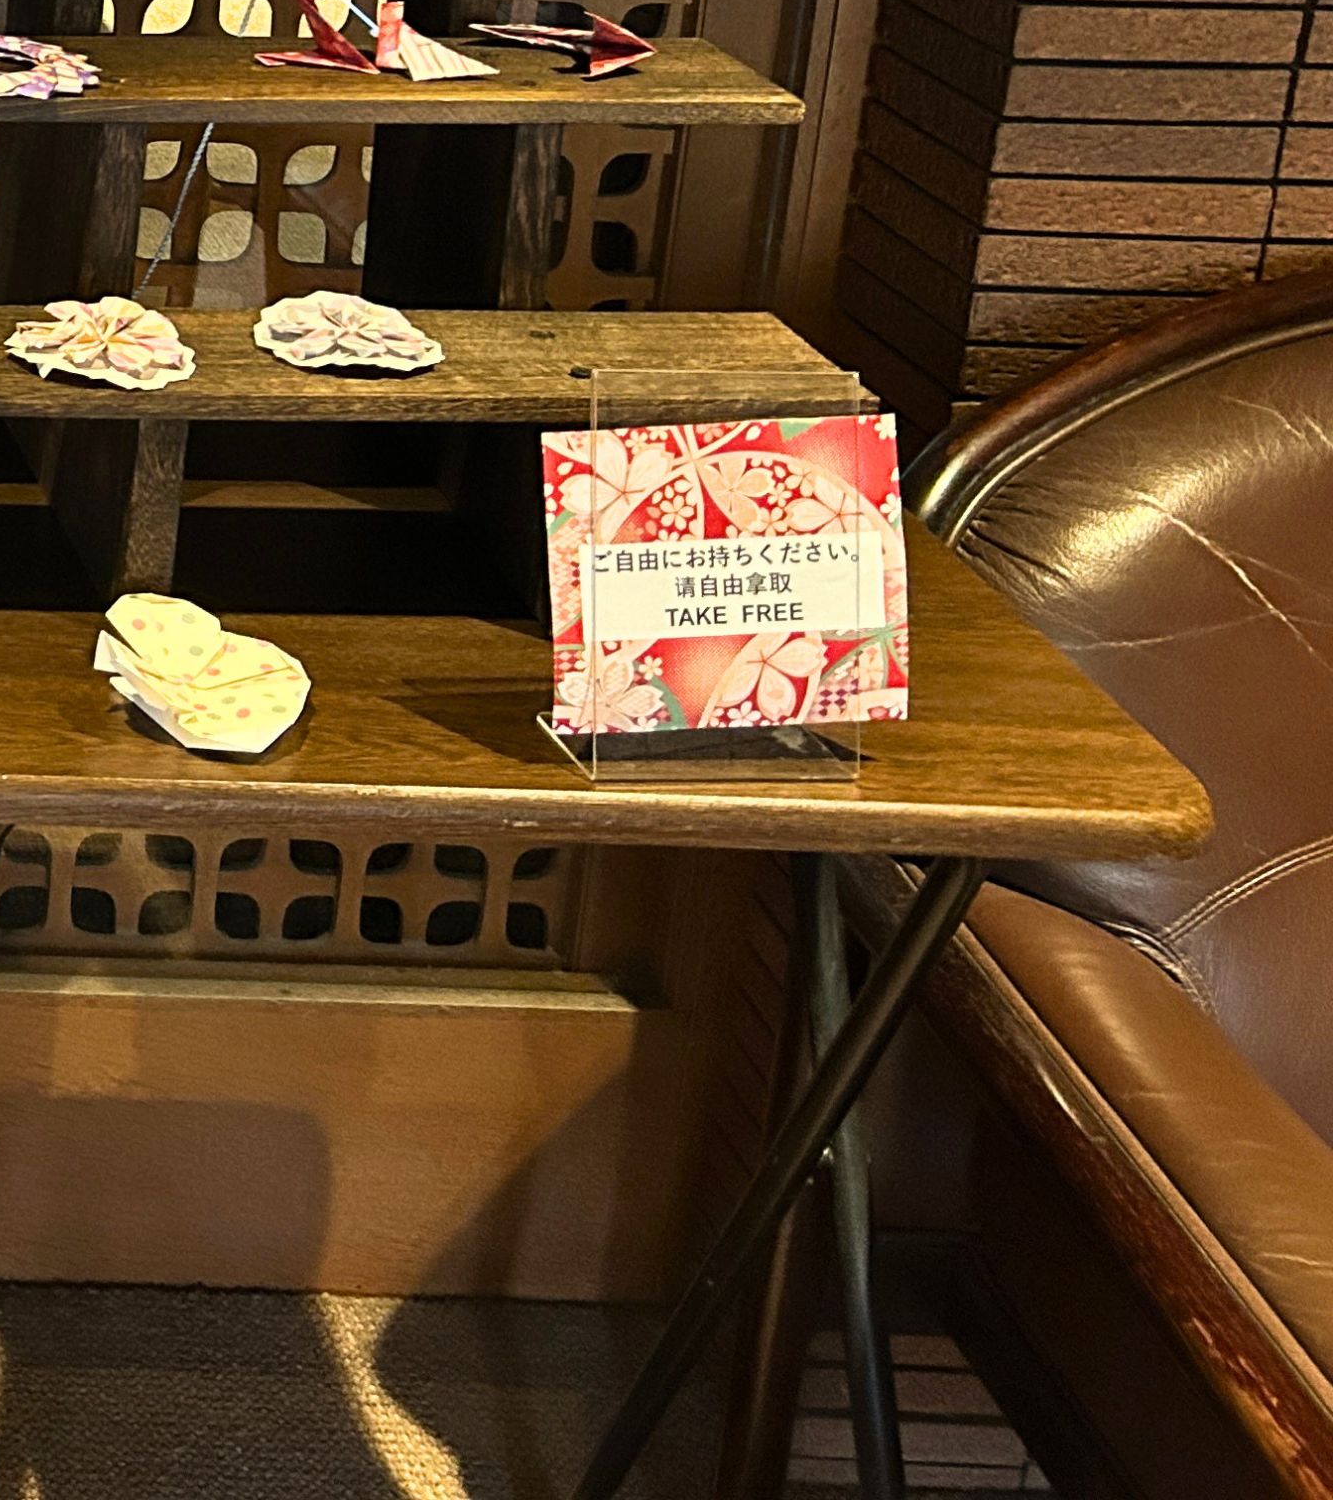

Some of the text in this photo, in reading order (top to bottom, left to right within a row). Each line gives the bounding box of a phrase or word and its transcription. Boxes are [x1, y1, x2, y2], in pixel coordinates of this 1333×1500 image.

[592, 541, 860, 573] ご自由にお持ちください。
[675, 571, 793, 599] 请自由拿取
[665, 602, 805, 628] TAKE FREE
